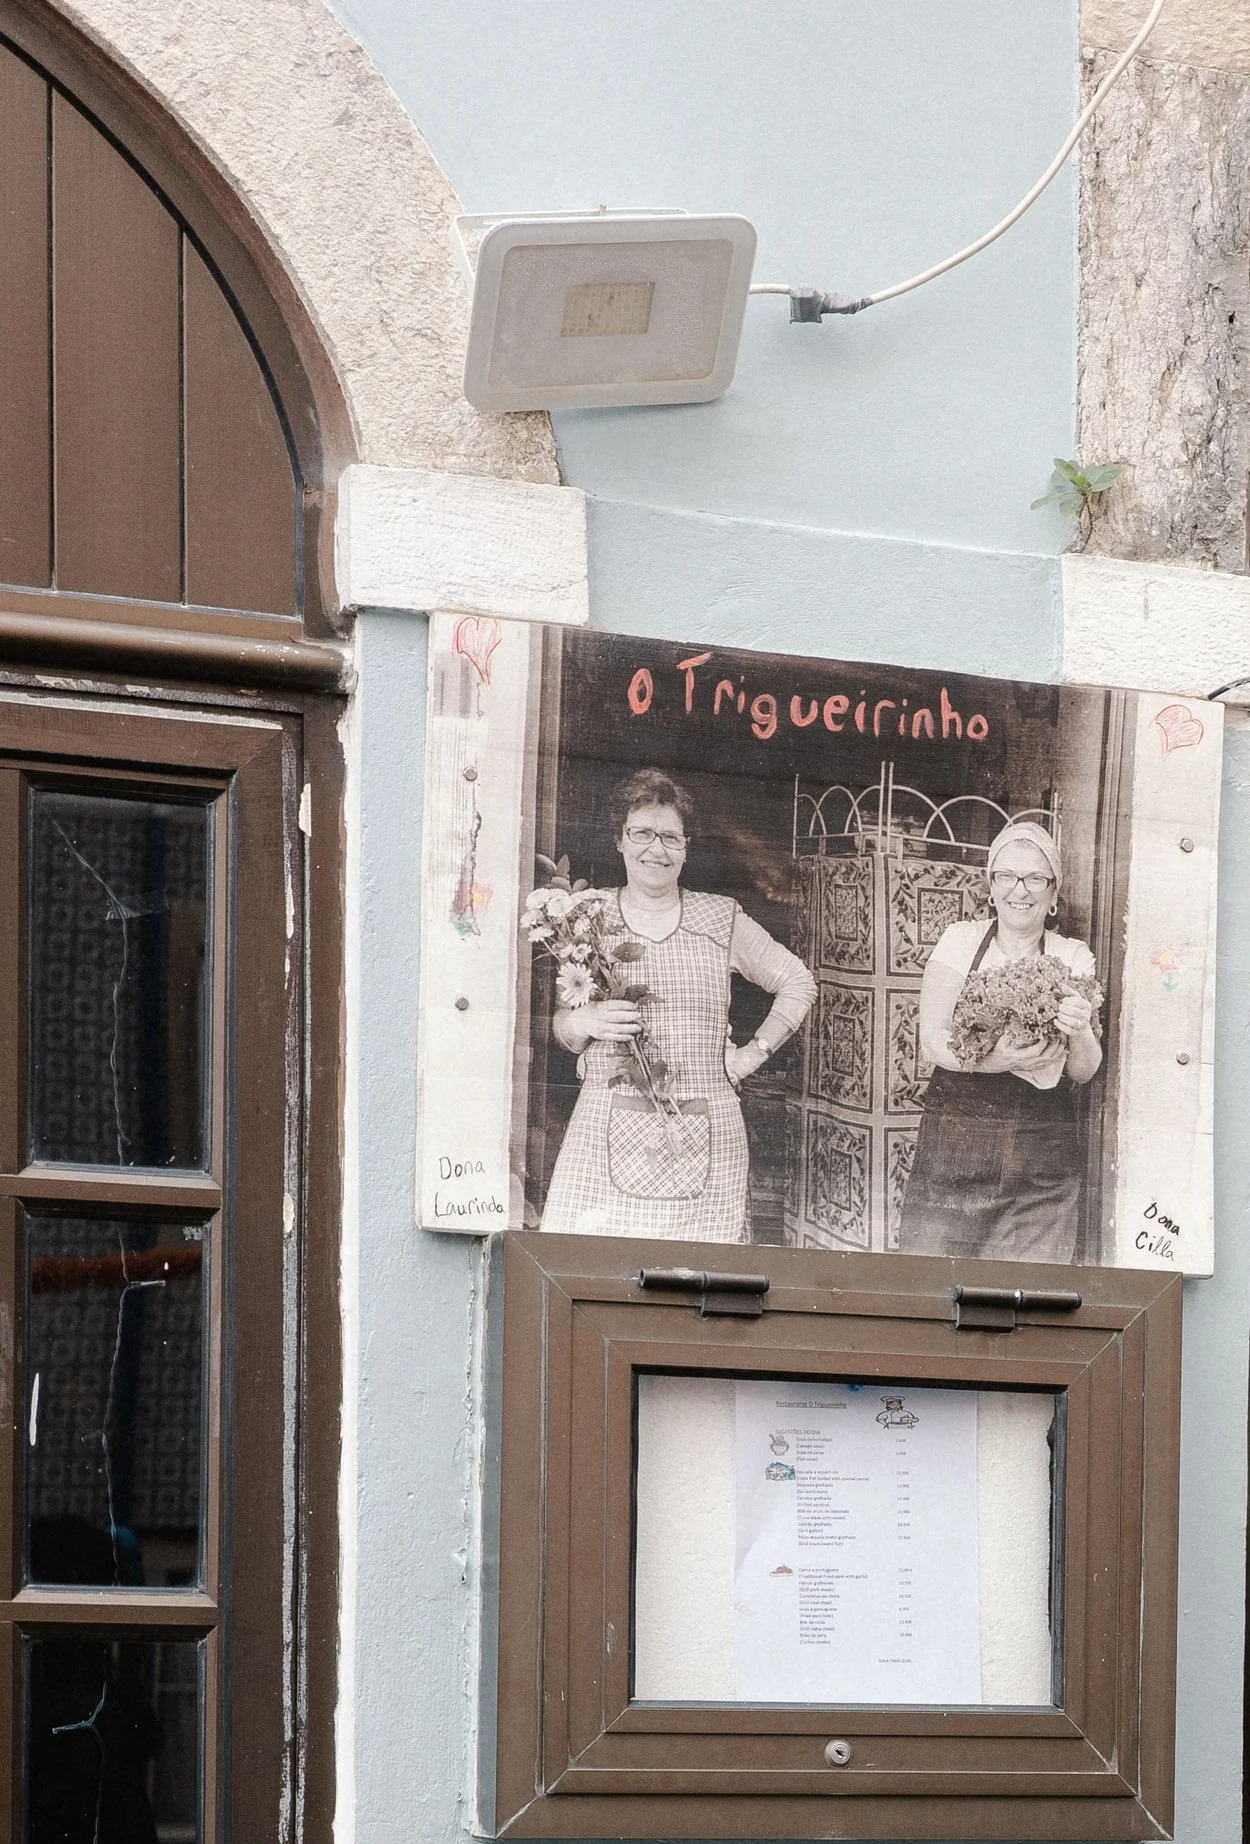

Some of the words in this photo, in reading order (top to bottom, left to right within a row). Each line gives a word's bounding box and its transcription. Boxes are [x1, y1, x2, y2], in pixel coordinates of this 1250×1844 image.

[628, 667, 654, 716] O
[677, 652, 989, 740] Trigueirinho
[438, 1156, 486, 1180] Dona
[435, 1191, 505, 1218] Laurinda
[1143, 1200, 1180, 1237] Dona
[1135, 1231, 1175, 1262] Cilla
